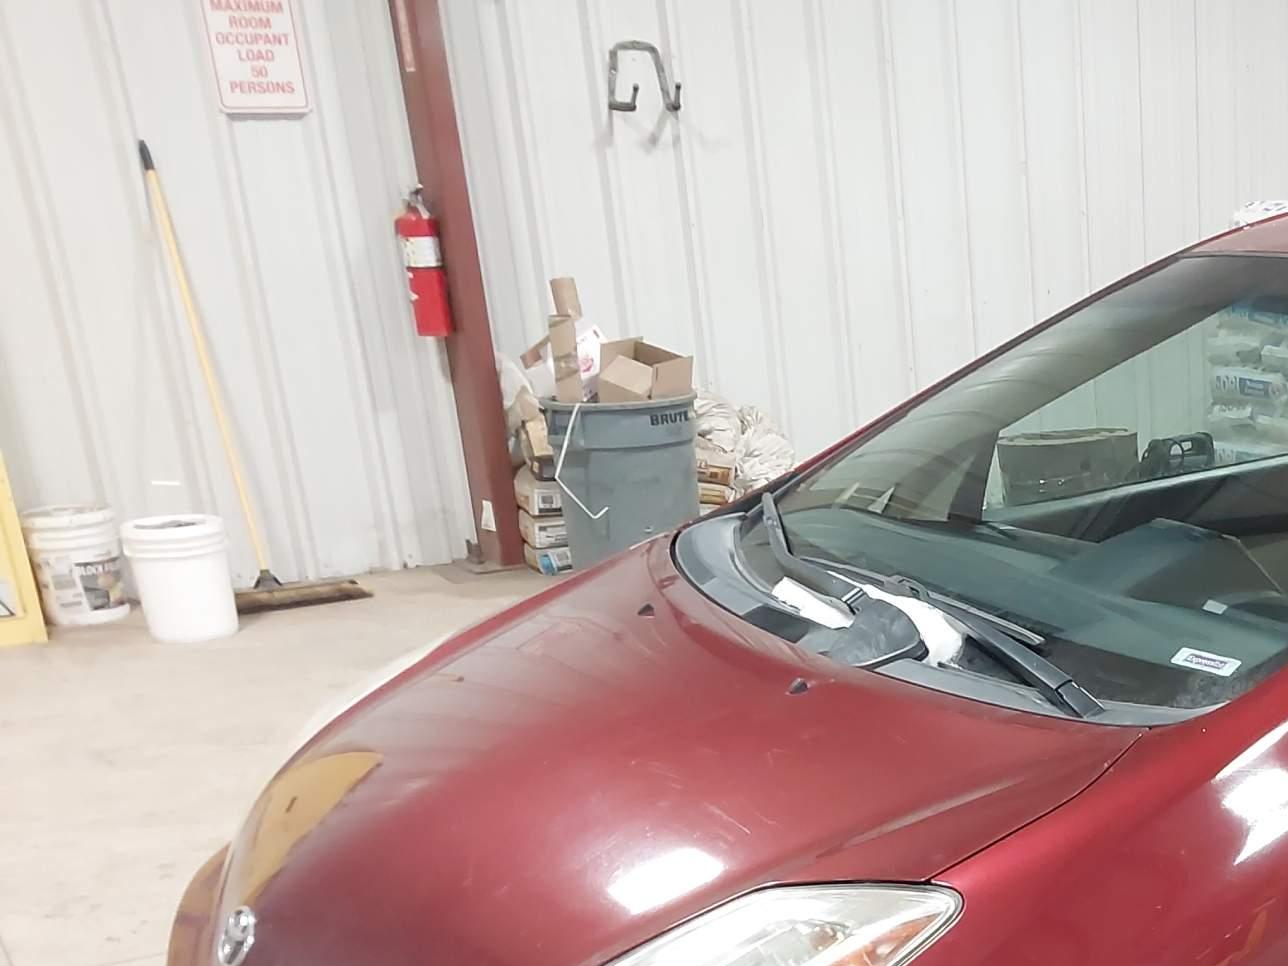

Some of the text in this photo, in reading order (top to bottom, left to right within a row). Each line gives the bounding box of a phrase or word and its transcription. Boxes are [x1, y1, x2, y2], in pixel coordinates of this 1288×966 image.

[210, 0, 284, 13] MAXIMUM
[228, 15, 272, 29] ROOM
[215, 32, 289, 45] OCCUPANT
[237, 49, 275, 61] LOAD
[250, 66, 268, 78] 50
[229, 80, 295, 94] PERSONS
[650, 410, 689, 426] BRUTE
